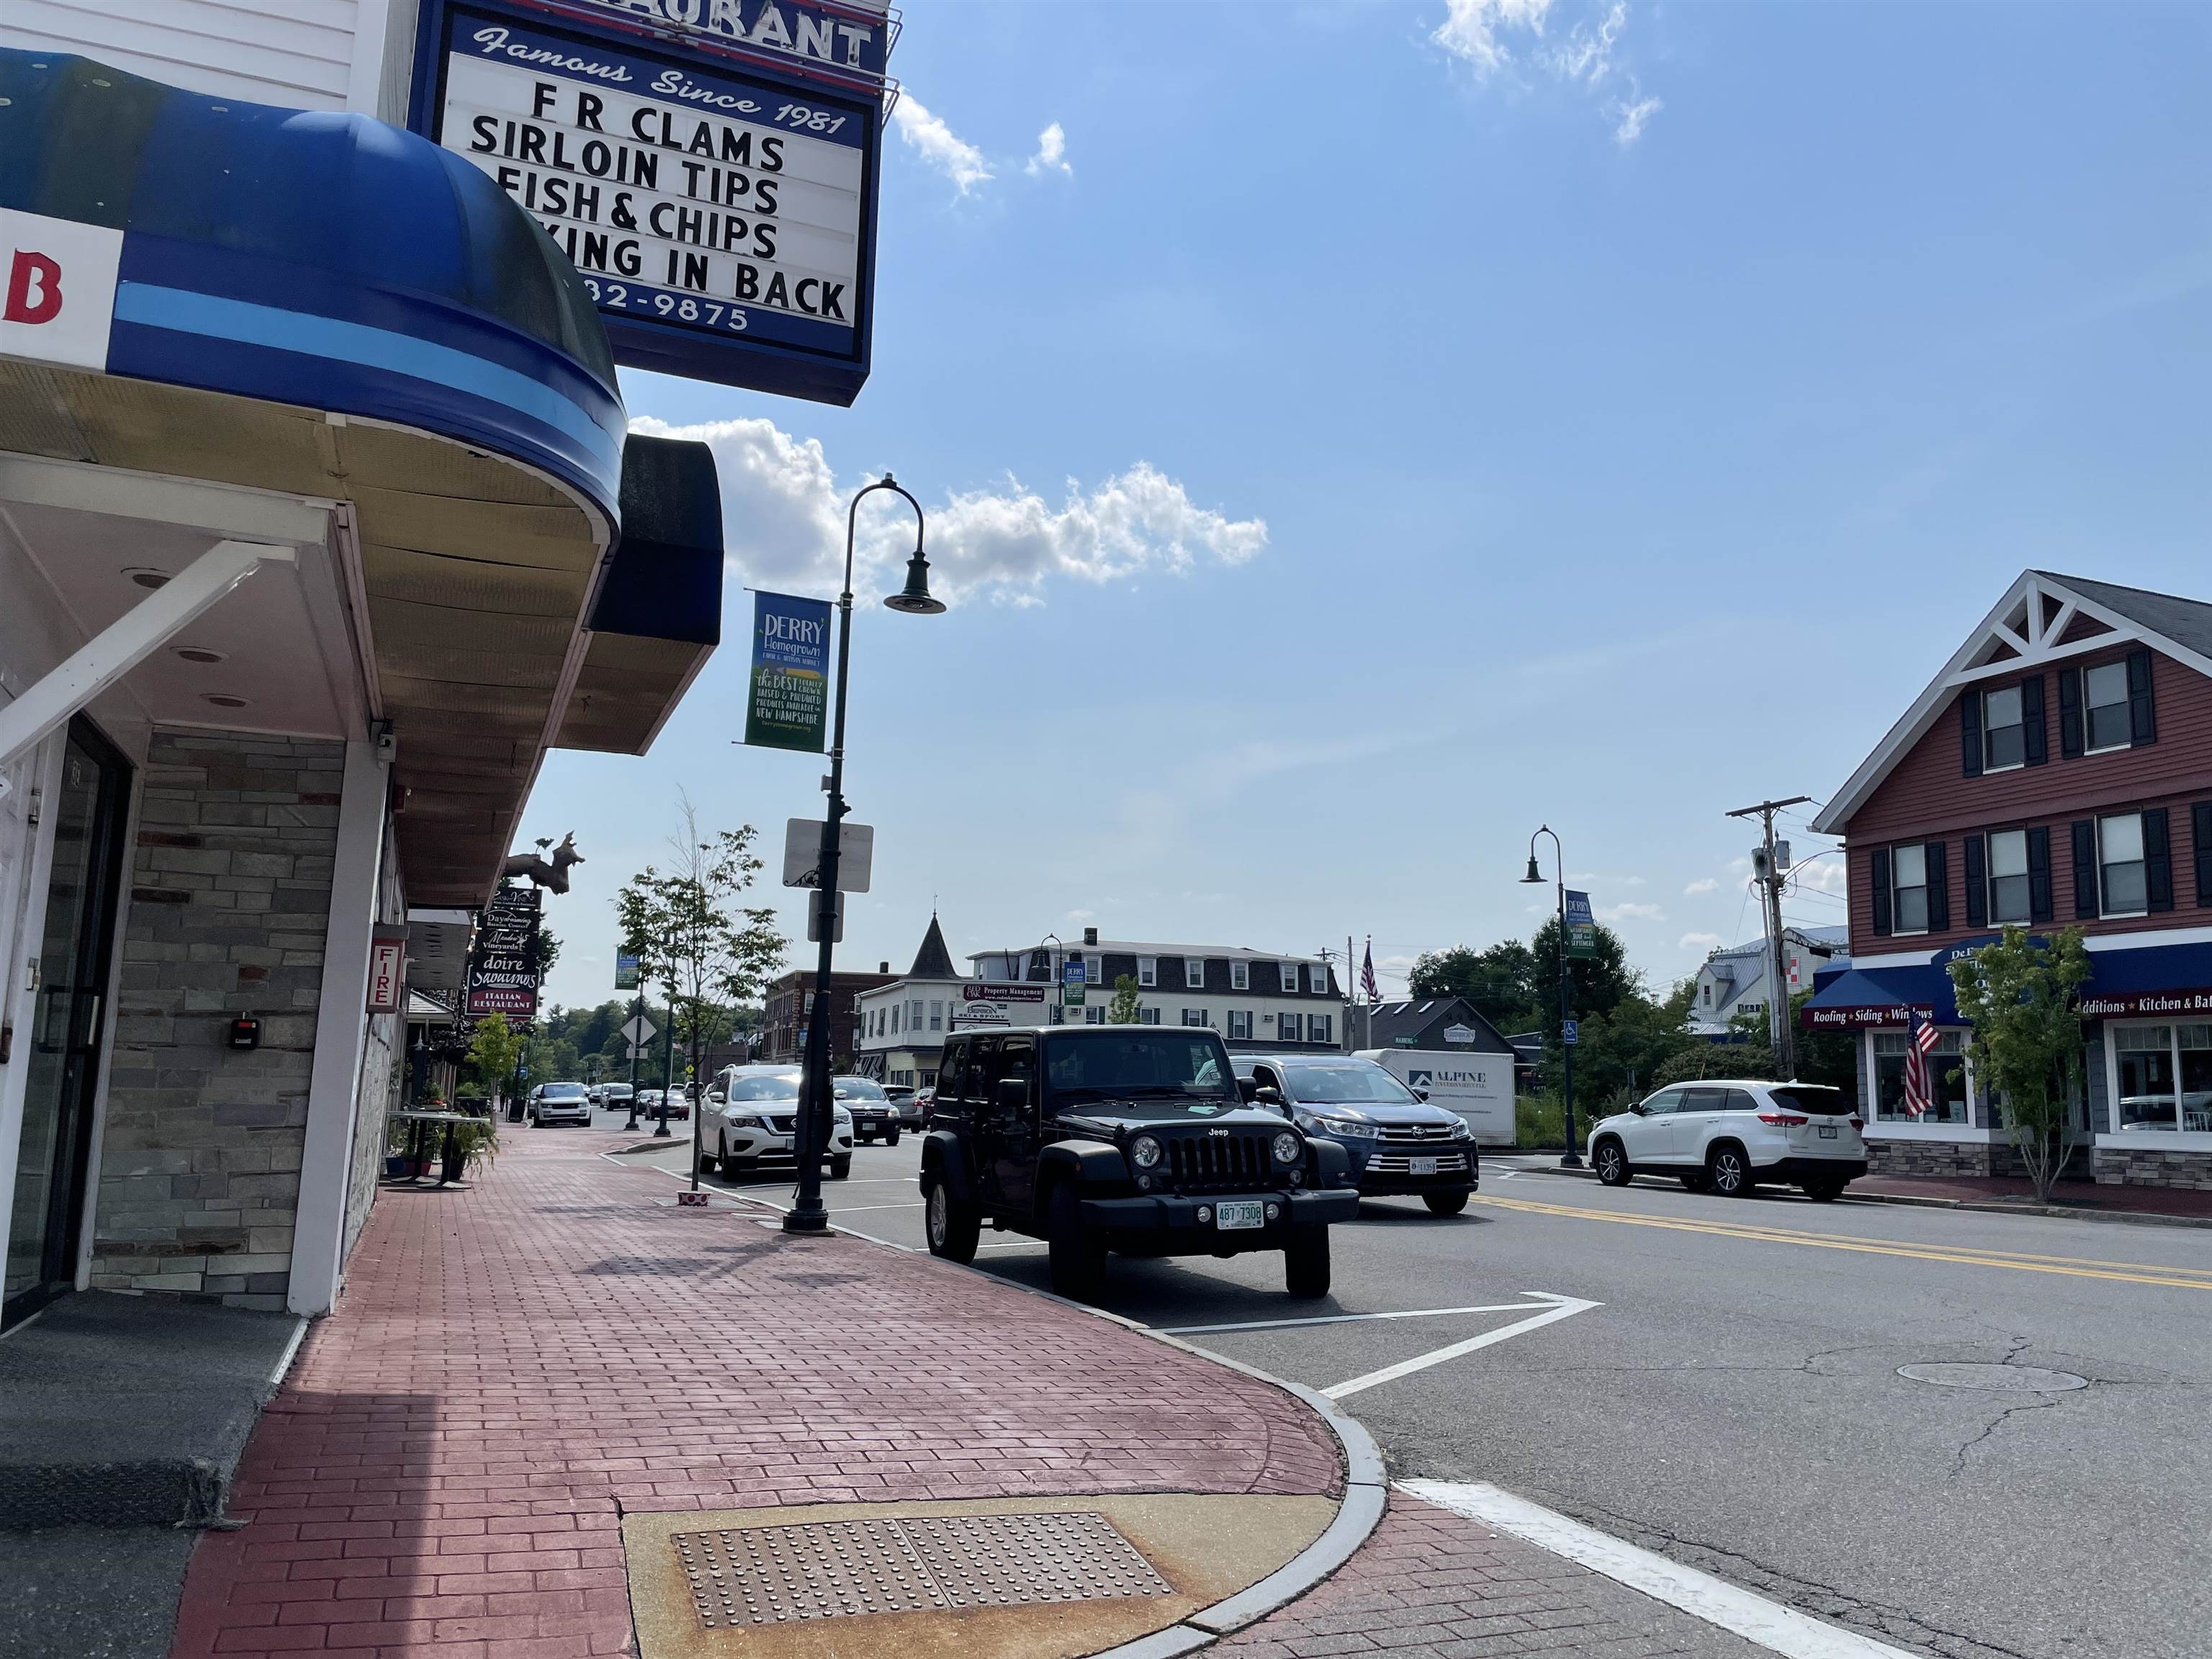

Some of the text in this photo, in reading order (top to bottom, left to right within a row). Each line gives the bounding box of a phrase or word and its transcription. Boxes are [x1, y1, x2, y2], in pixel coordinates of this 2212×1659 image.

[474, 27, 846, 135] Famous Since 1981
[631, 107, 784, 171] CLAMS
[471, 115, 778, 215] SIRLOIN TIPS
[1, 248, 63, 324] B
[667, 249, 709, 292] IN
[735, 264, 846, 320] BACK
[765, 613, 824, 644] DERRY
[764, 636, 820, 657] Homegrown
[755, 668, 798, 691] the BEST
[799, 679, 822, 688] LOCALLY
[756, 698, 784, 709] PRODUCTS
[786, 701, 814, 712] AVAILABLE
[757, 688, 821, 705] RAISED & PRODUCED
[755, 707, 818, 725] NEW HAMPSHIRE
[482, 942, 518, 950] Vineyards
[483, 955, 525, 971] doire
[375, 948, 393, 1003] FIRE
[984, 986, 1043, 996] Property Management
[2082, 999, 2125, 1014] dditions
[2139, 996, 2181, 1011] Kitchen
[2184, 997, 2192, 1009] &
[1814, 1007, 1933, 1025] Roofing Siding Winows
[1436, 1071, 1486, 1083] ALPINE
[1208, 1128, 1229, 1137] Jeep
[1219, 1206, 1262, 1220] 487 7308
